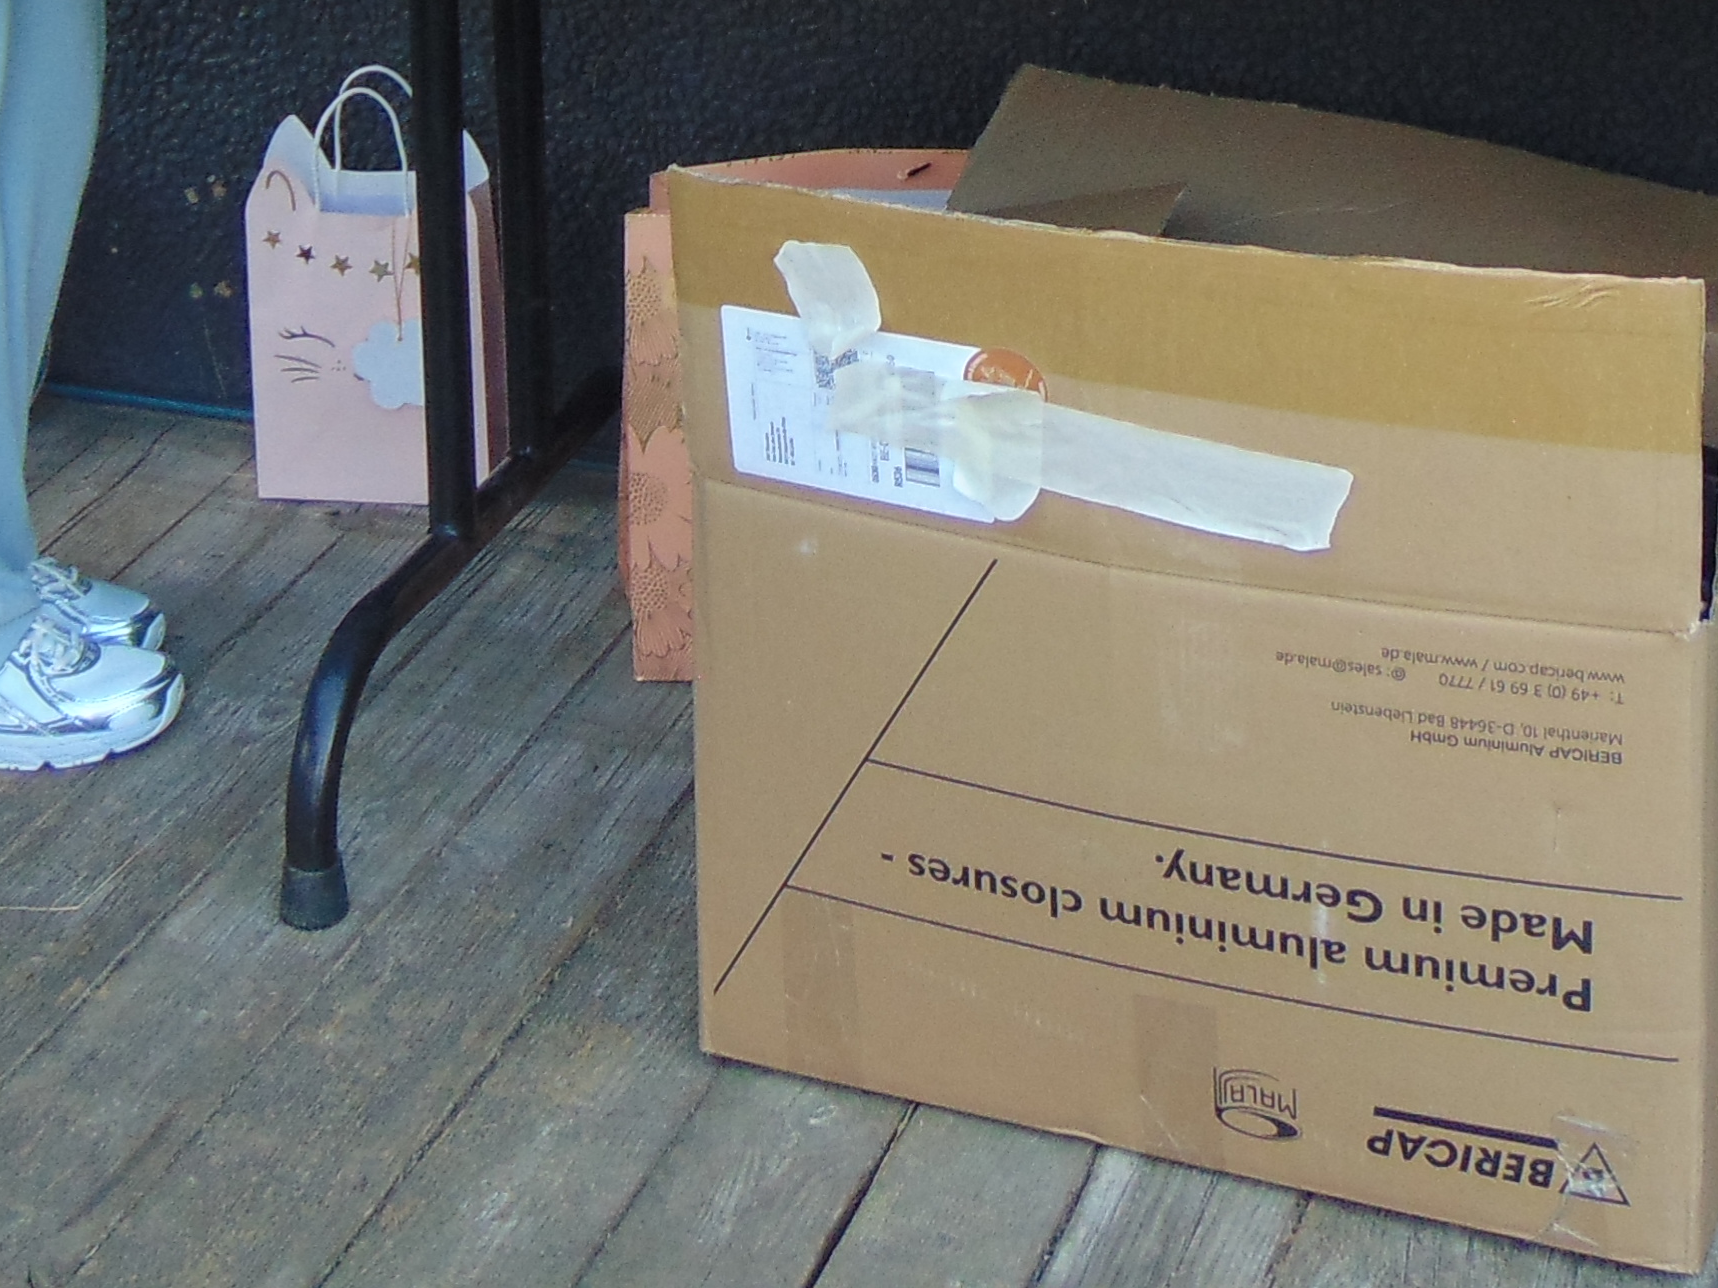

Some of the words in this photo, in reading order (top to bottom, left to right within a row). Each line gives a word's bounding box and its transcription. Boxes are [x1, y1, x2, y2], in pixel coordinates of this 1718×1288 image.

[1276, 651, 1382, 677] sales@mala.de
[1381, 648, 1477, 670] www.mala.de
[1439, 673, 1474, 690] 7770
[1494, 661, 1624, 685] www.bericap.com
[1490, 679, 1505, 694] 61
[1510, 682, 1528, 696] 69
[1534, 683, 1542, 698] 3
[1548, 683, 1566, 699] (0)
[1571, 688, 1600, 701] +49
[1609, 691, 1624, 704] T:
[1331, 702, 1413, 724] Liebenstein
[1418, 712, 1445, 728] Bad
[1450, 717, 1514, 736] D-36448
[1520, 723, 1538, 738] 10,
[1543, 726, 1623, 745] Marienthal
[1410, 730, 1458, 747] GmbH
[1463, 736, 1544, 757] Aluminium
[1549, 745, 1622, 764] BERICAP
[908, 854, 1081, 918] closures
[1152, 847, 1385, 925] Germany.
[1403, 897, 1441, 933] in
[1097, 897, 1345, 973] aluminium
[1462, 906, 1592, 954] Made
[1366, 943, 1592, 1011] Premium
[1227, 1084, 1297, 1120] MALA
[1367, 1127, 1557, 1188] BERICAP
